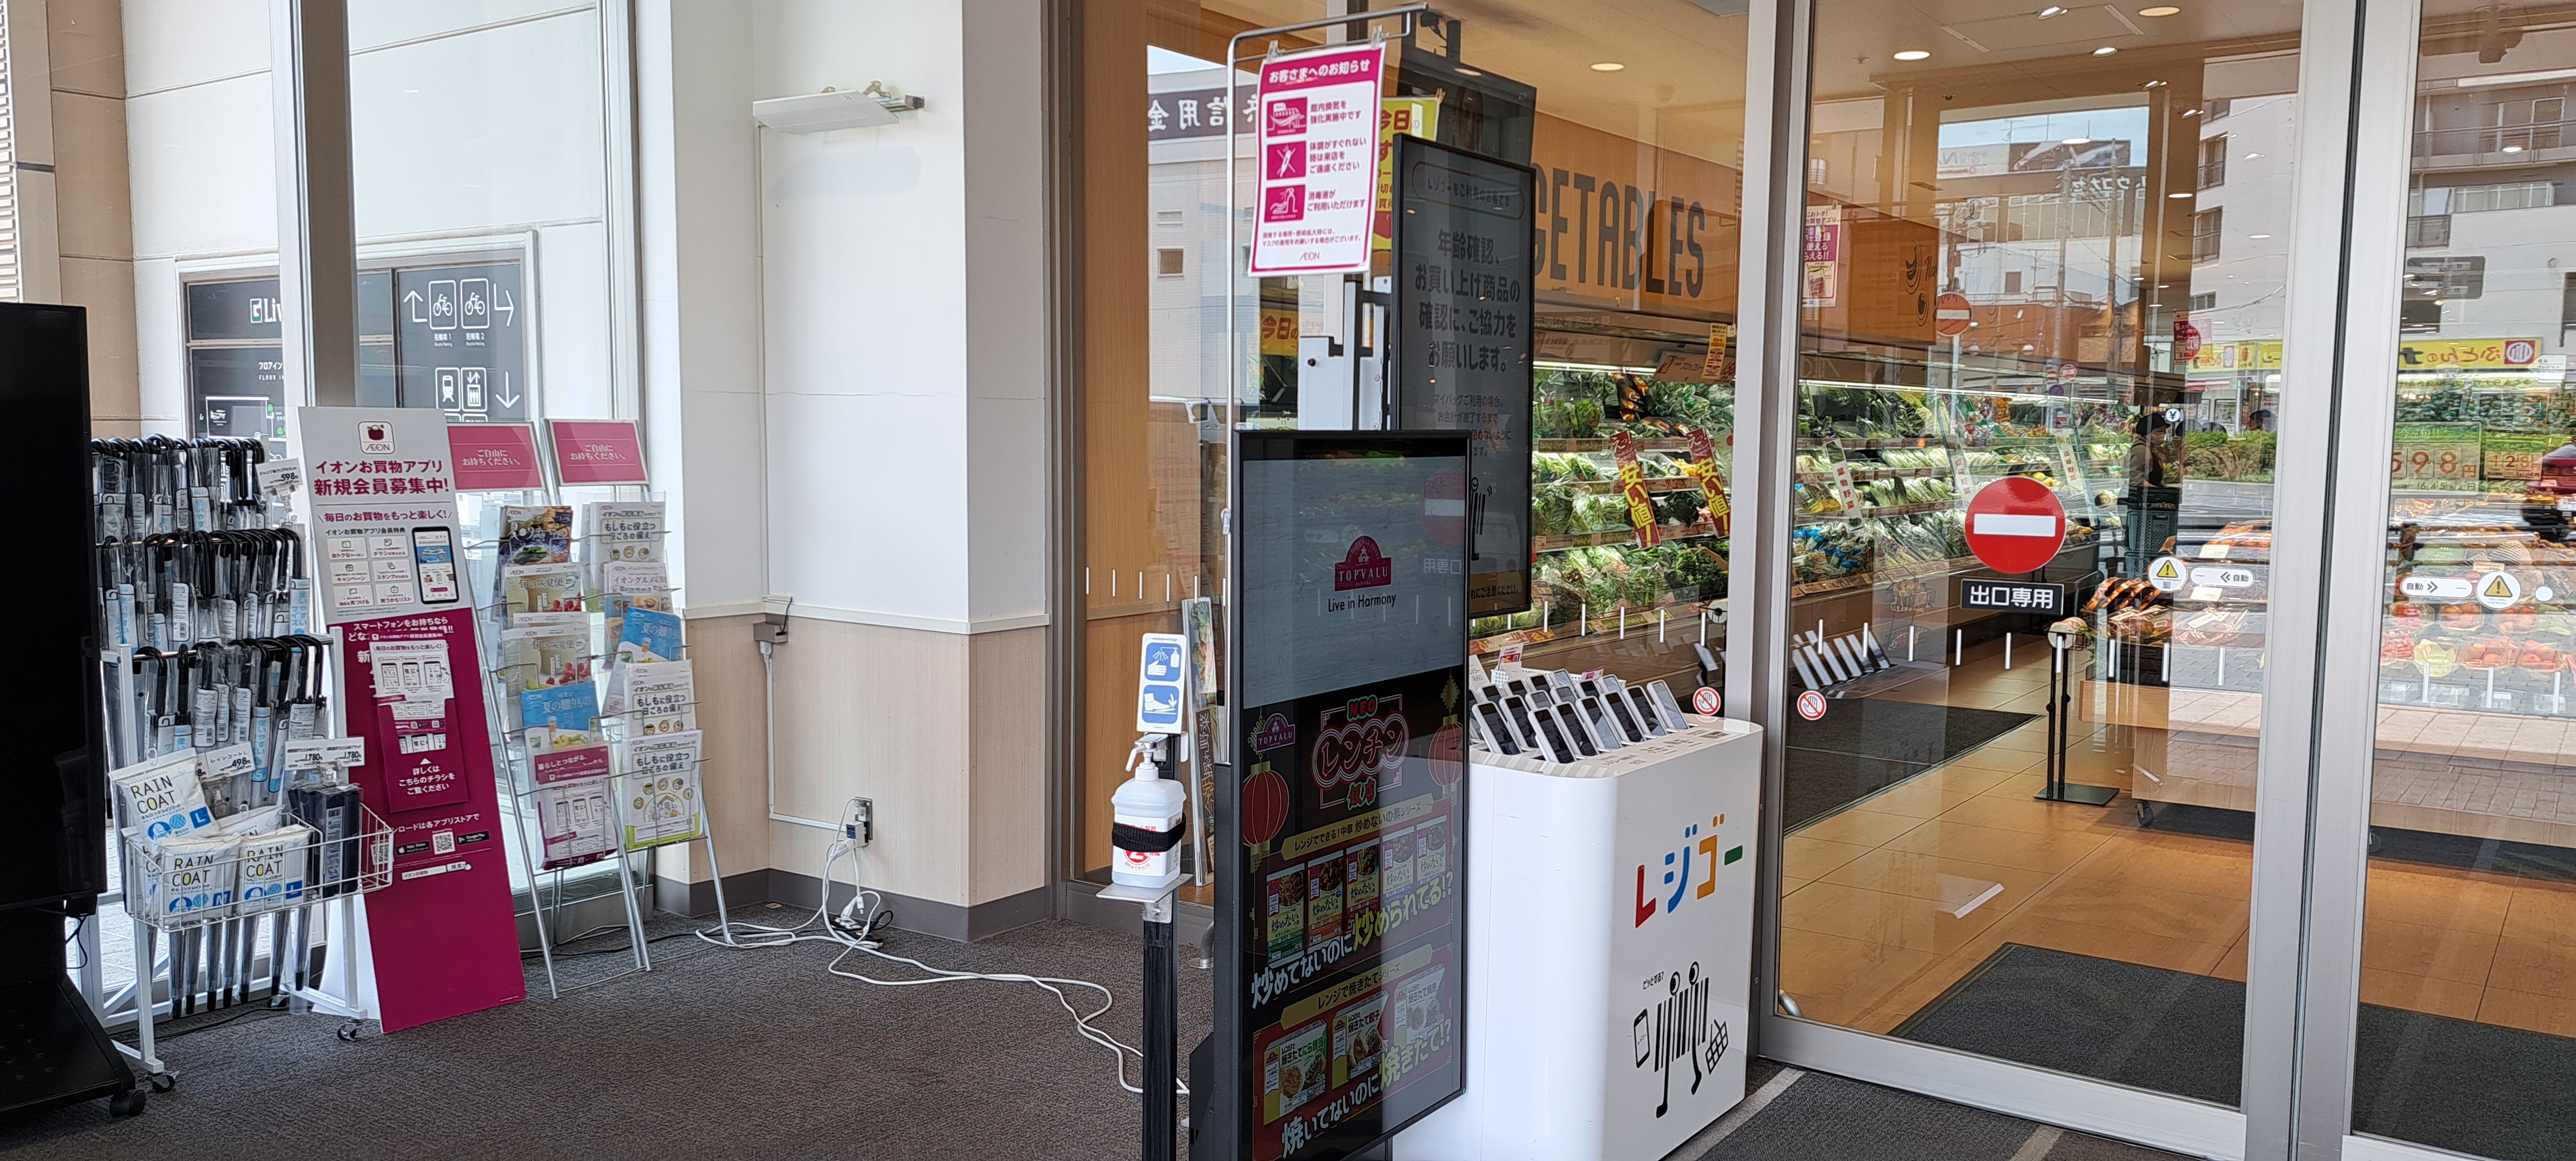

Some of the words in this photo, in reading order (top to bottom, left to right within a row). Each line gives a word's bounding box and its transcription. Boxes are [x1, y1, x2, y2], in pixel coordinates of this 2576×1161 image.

[1269, 58, 1370, 83] お客さまへのお知らせ
[1310, 110, 1362, 124] 強化実施中です
[1309, 137, 1367, 151] 体調がすぐれない
[1309, 150, 1345, 163] 時は来店を
[1309, 161, 1360, 174] ご遠慮ください
[1308, 188, 1336, 200] 消毒液が
[1307, 198, 1366, 212] ご利用いただけます
[1415, 263, 1521, 304] お買い上げ商品の
[1418, 301, 1517, 338] 確認に、ご協力を
[1428, 340, 1506, 373] お願いします。
[476, 448, 509, 457] ご自由に
[569, 451, 627, 461] お持ちください。
[315, 460, 443, 475] イオンお買物アプリ
[462, 457, 521, 467] お持ちください。
[314, 477, 450, 496] 新規会員募集中!
[1619, 460, 1653, 547] 安い値!
[1696, 458, 1730, 535] 安い値!
[324, 509, 447, 523] 毎日のお買物をもっと楽しく!
[325, 526, 406, 536] イオンお買物アプリ会員特典
[1338, 565, 1388, 582] TOPVALU
[2233, 574, 2249, 582] 自動
[2406, 583, 2423, 591] 自動
[1328, 597, 1345, 612] Live
[1348, 596, 1355, 609] in
[1358, 593, 1397, 608] Harmony
[1969, 586, 2053, 609] 出口専用
[353, 616, 448, 631] スマートフォンをお持ちなら
[1349, 697, 1376, 719] NEO
[1258, 730, 1293, 745] TOPVALU
[1320, 723, 1404, 778] レンチン
[636, 753, 690, 767] もしもに役立つ
[412, 765, 441, 775] 詳しくは
[130, 775, 173, 799] RAIN
[398, 772, 456, 787] こちらのチラシを
[407, 783, 450, 796] ご覧ください
[136, 789, 175, 814] COAT
[247, 844, 284, 863] RAIN
[174, 854, 214, 870] RAIN
[246, 860, 283, 877] COAT
[172, 869, 211, 887] COAT
[1635, 813, 1743, 929] レジゴー
[1251, 933, 1353, 1010] 炒めてないのに
[1281, 1073, 1380, 1160] 焼いてないのに
